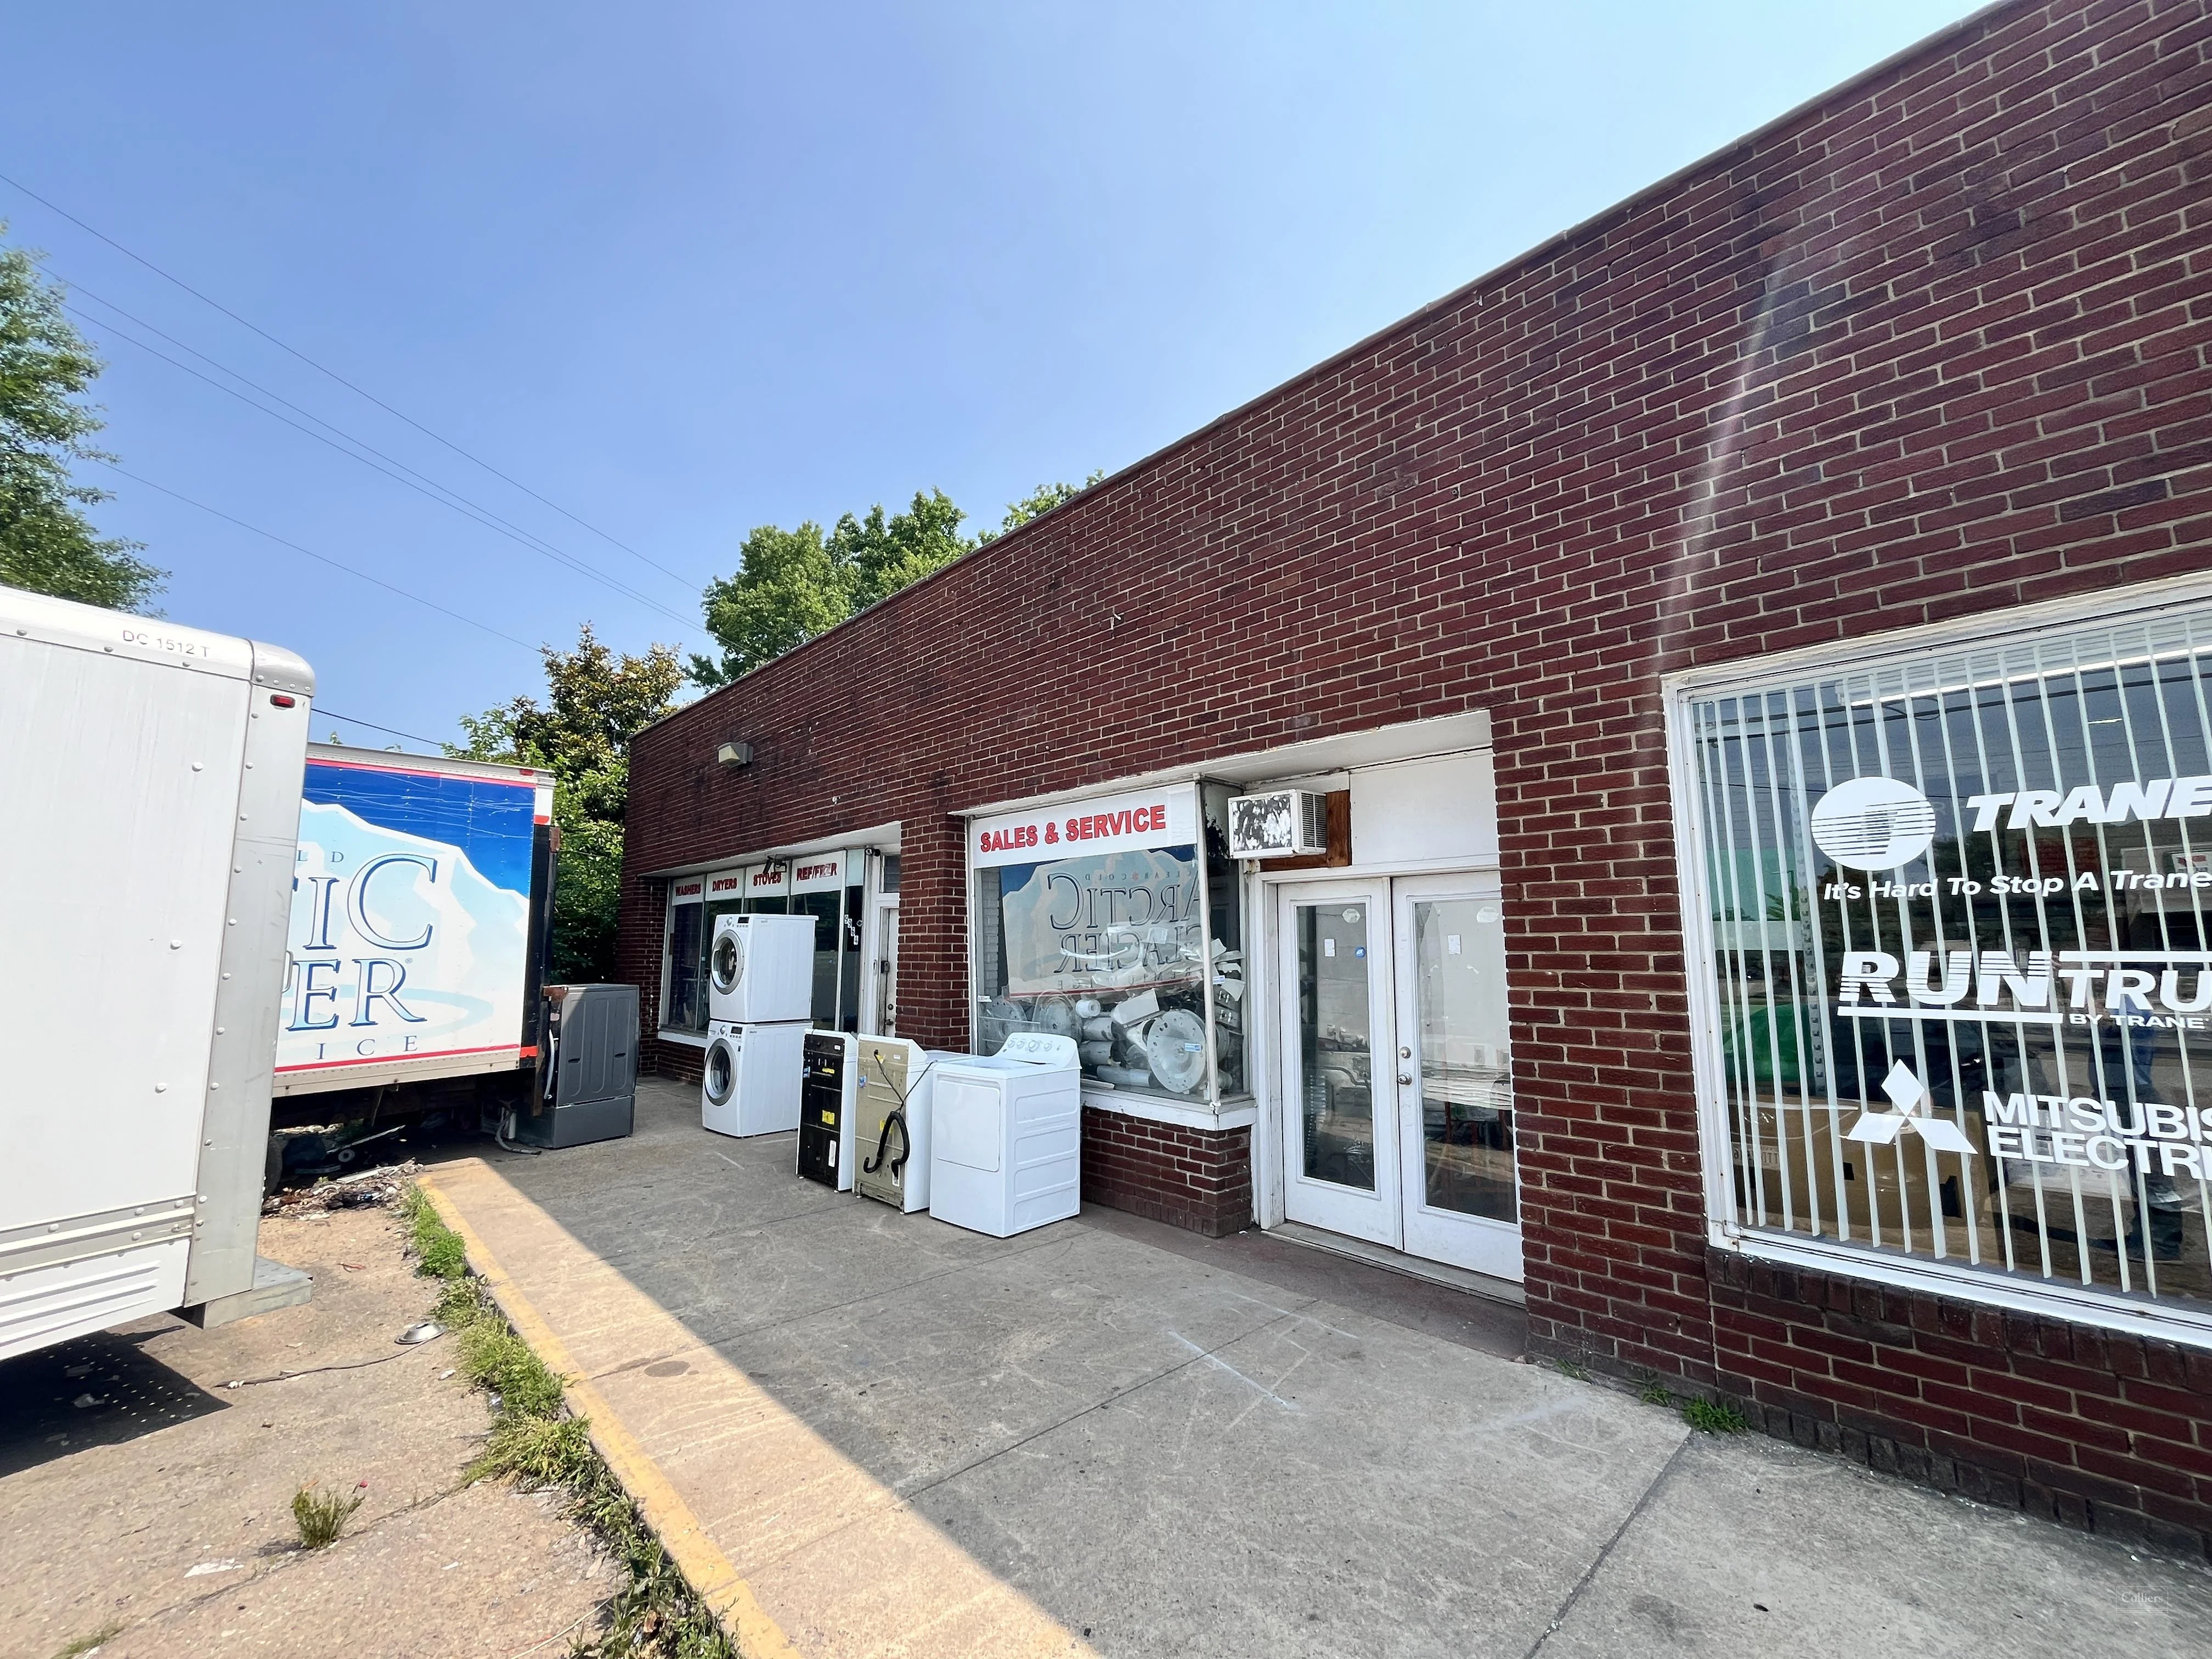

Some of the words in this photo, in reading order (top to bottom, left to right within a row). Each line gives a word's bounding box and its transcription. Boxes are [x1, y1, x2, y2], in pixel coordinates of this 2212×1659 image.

[123, 630, 148, 645] DC
[156, 637, 194, 654] 1512
[200, 646, 210, 657] T
[1966, 774, 2212, 832] TRANE
[980, 825, 1038, 853] SALES
[1044, 822, 1060, 844] &
[1065, 805, 1166, 842] SERVICE
[675, 883, 701, 896] WASHERS
[712, 877, 737, 891] DRYERS
[753, 872, 782, 886] STOVES
[1824, 880, 1861, 900] It's
[1869, 878, 1939, 899] Hard
[1947, 877, 1982, 896] To
[1989, 874, 2064, 898] Stop
[2072, 871, 2100, 891] A
[292, 854, 438, 950] IC
[2069, 1013, 2103, 1025] BY
[2109, 1014, 2205, 1029] TRANE
[315, 1035, 418, 1060] ICE
